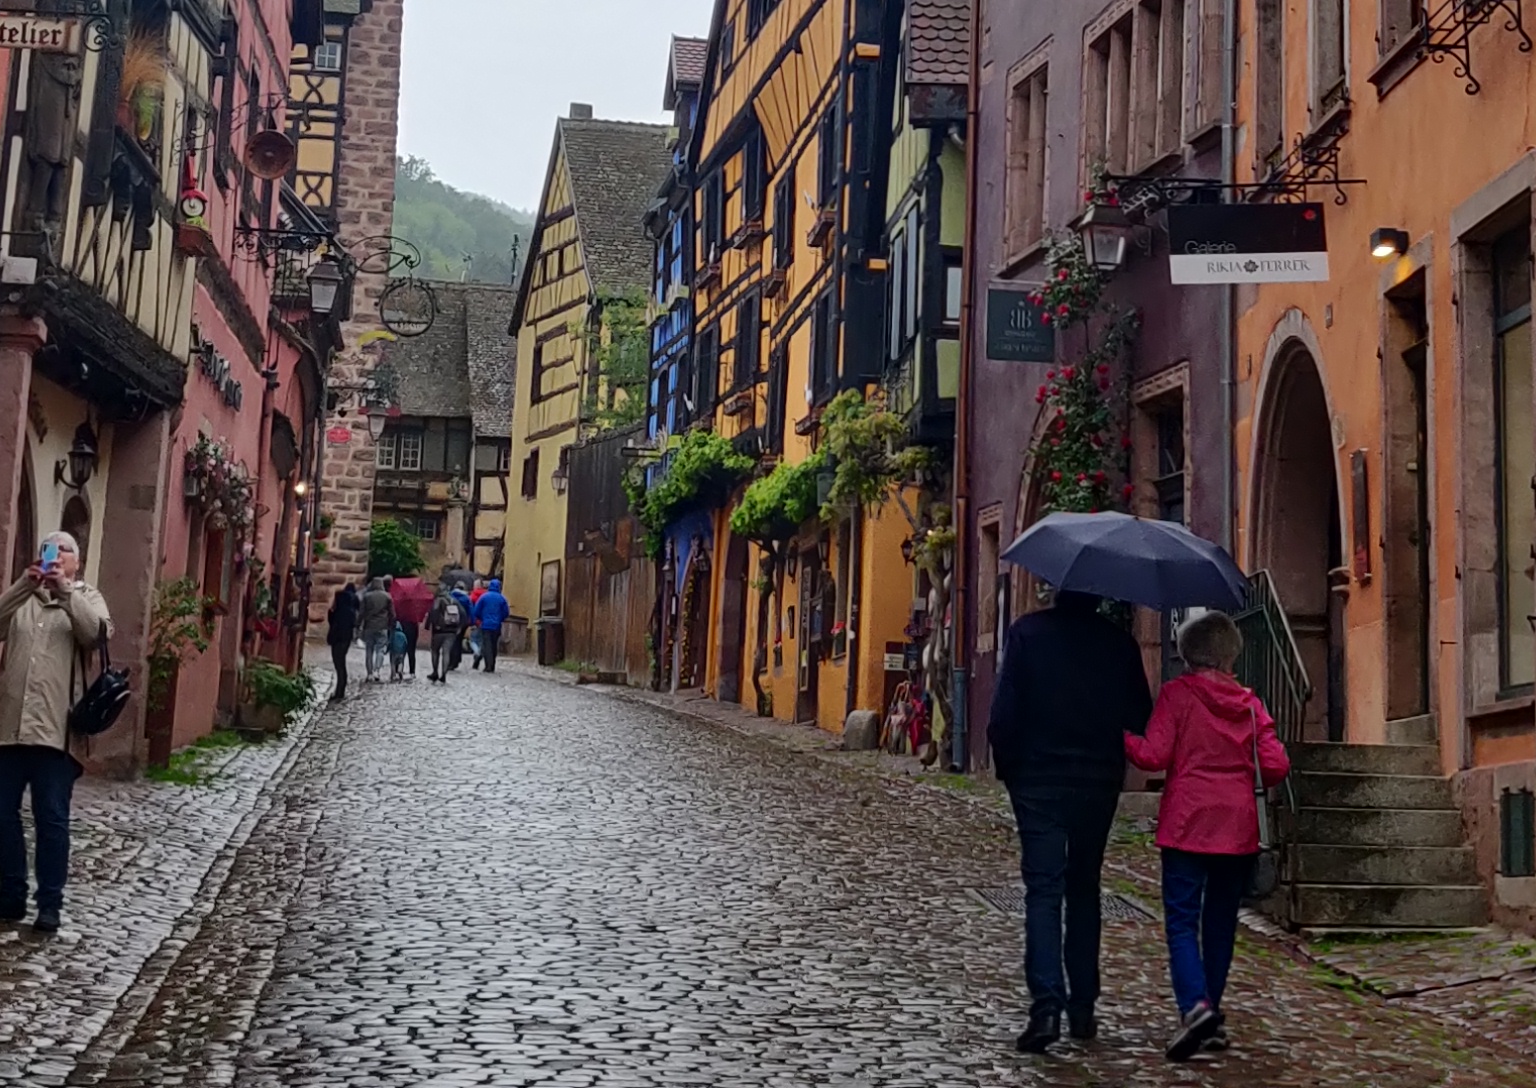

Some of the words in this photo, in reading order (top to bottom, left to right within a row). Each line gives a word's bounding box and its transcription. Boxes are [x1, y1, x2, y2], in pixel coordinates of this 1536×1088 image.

[1184, 240, 1237, 255] Galerie
[1207, 260, 1243, 274] RIKIA
[1260, 259, 1311, 272] FERRER
